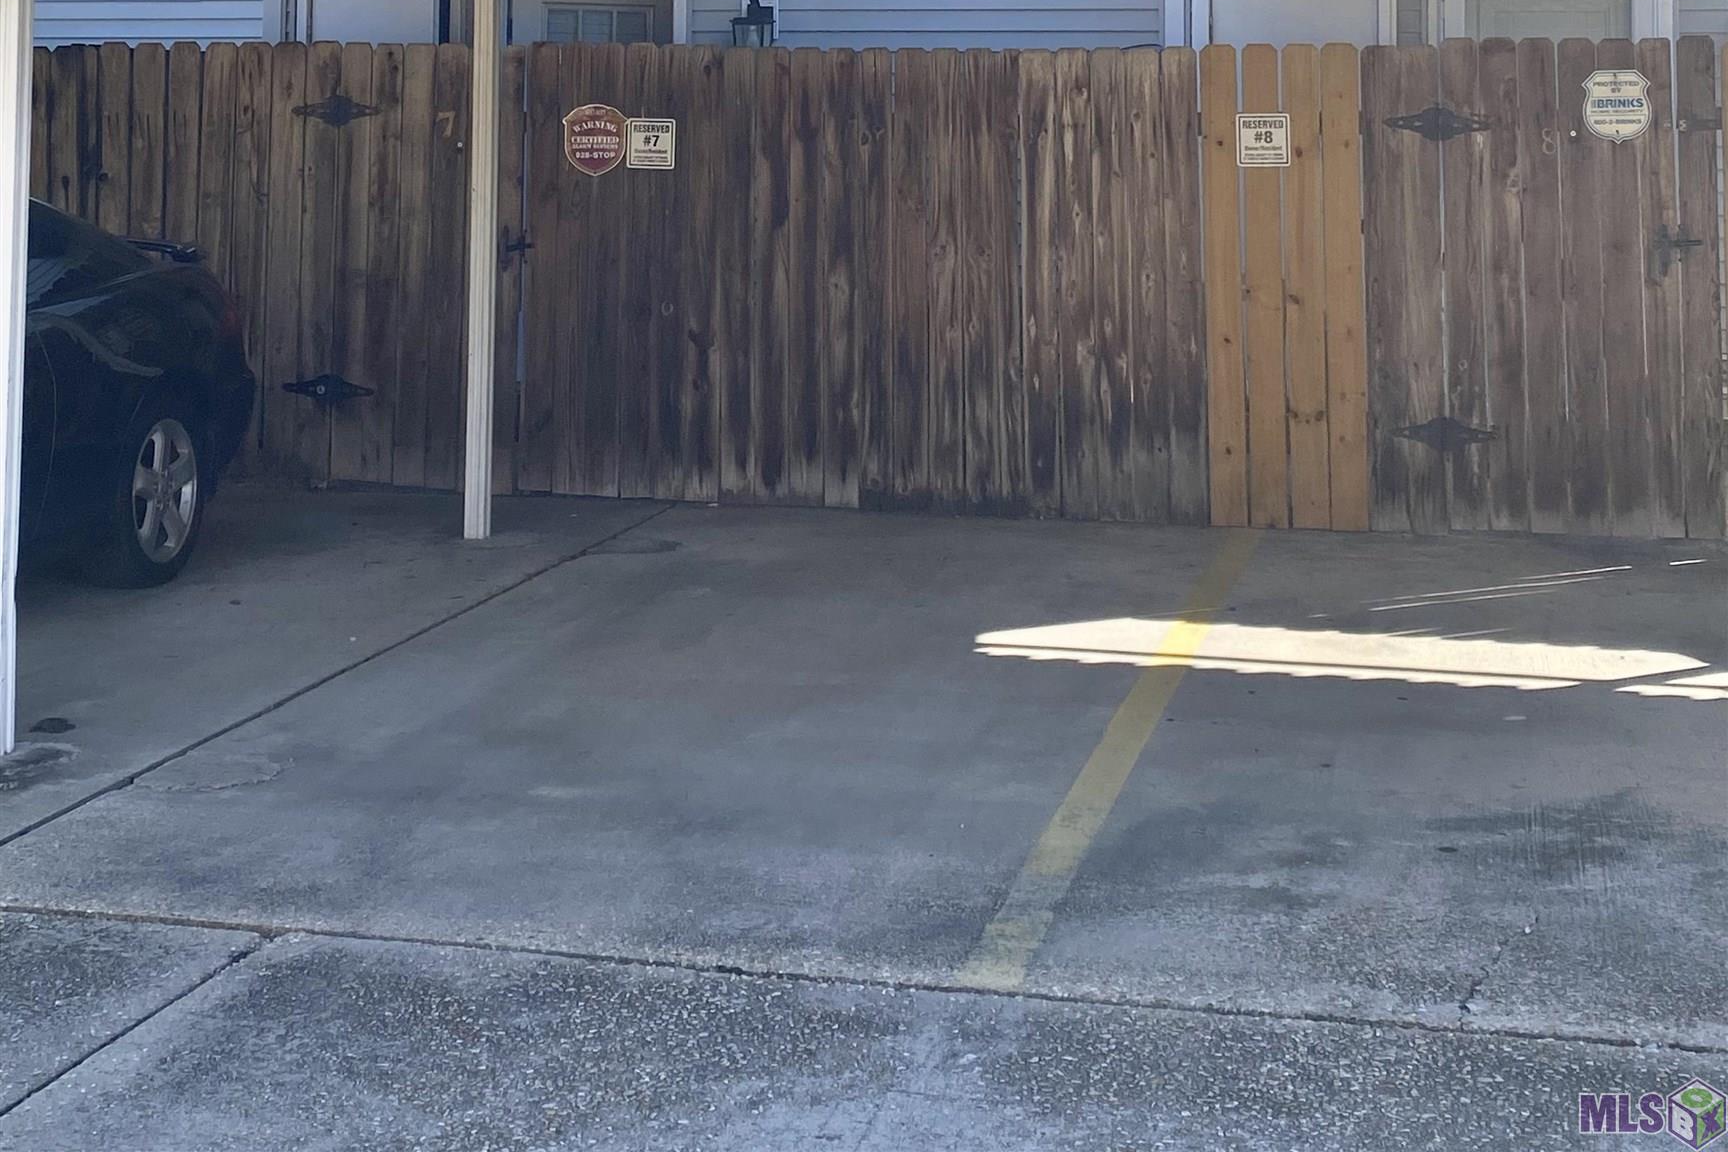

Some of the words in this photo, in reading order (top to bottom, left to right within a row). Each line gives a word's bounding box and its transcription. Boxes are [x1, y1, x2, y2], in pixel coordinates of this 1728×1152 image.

[1597, 98, 1644, 108] BRINKS
[572, 120, 617, 133] WARNING
[633, 124, 670, 133] RESERVED
[1242, 119, 1284, 129] RESERVED
[643, 134, 660, 147] #7
[1254, 130, 1273, 144] #8
